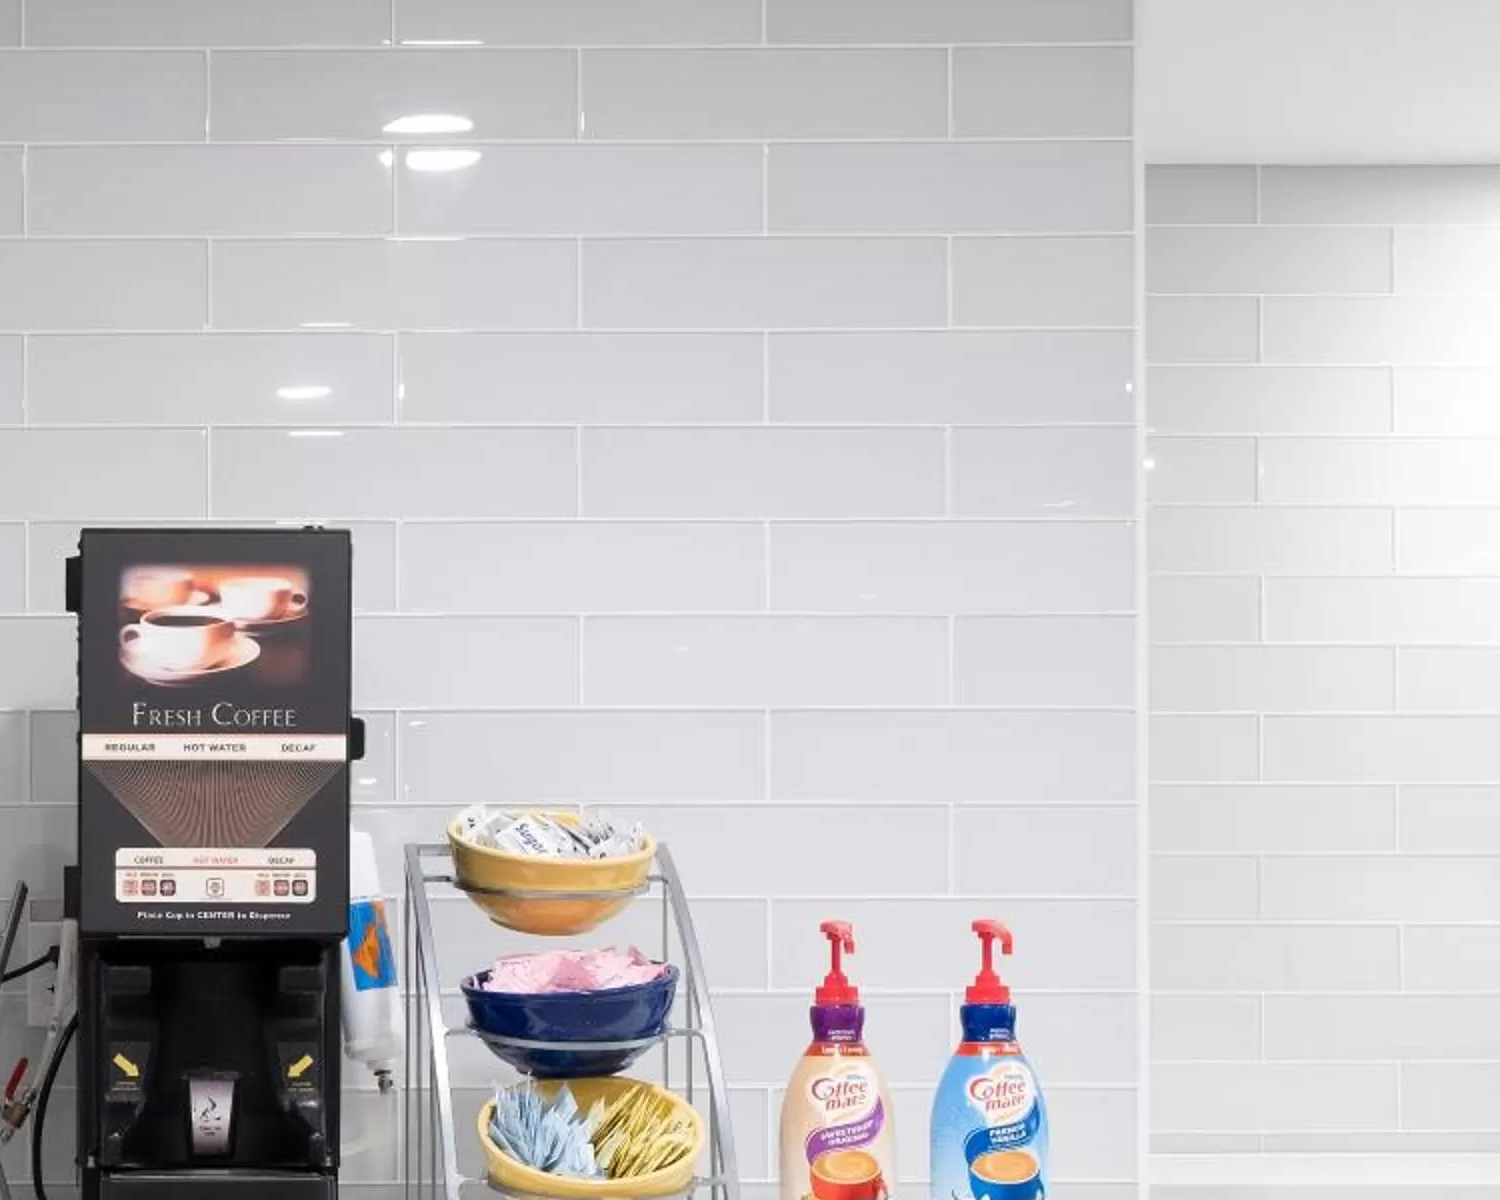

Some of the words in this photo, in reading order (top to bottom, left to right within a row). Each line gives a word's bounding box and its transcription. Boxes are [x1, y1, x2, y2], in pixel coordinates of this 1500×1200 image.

[104, 742, 156, 753] REGULAR
[183, 742, 207, 753] HOT
[209, 742, 247, 753] WATER
[280, 742, 316, 753] DECAF
[197, 911, 235, 920] CENTER
[811, 1077, 868, 1101] Coffee
[969, 1077, 1027, 1101] Coffee
